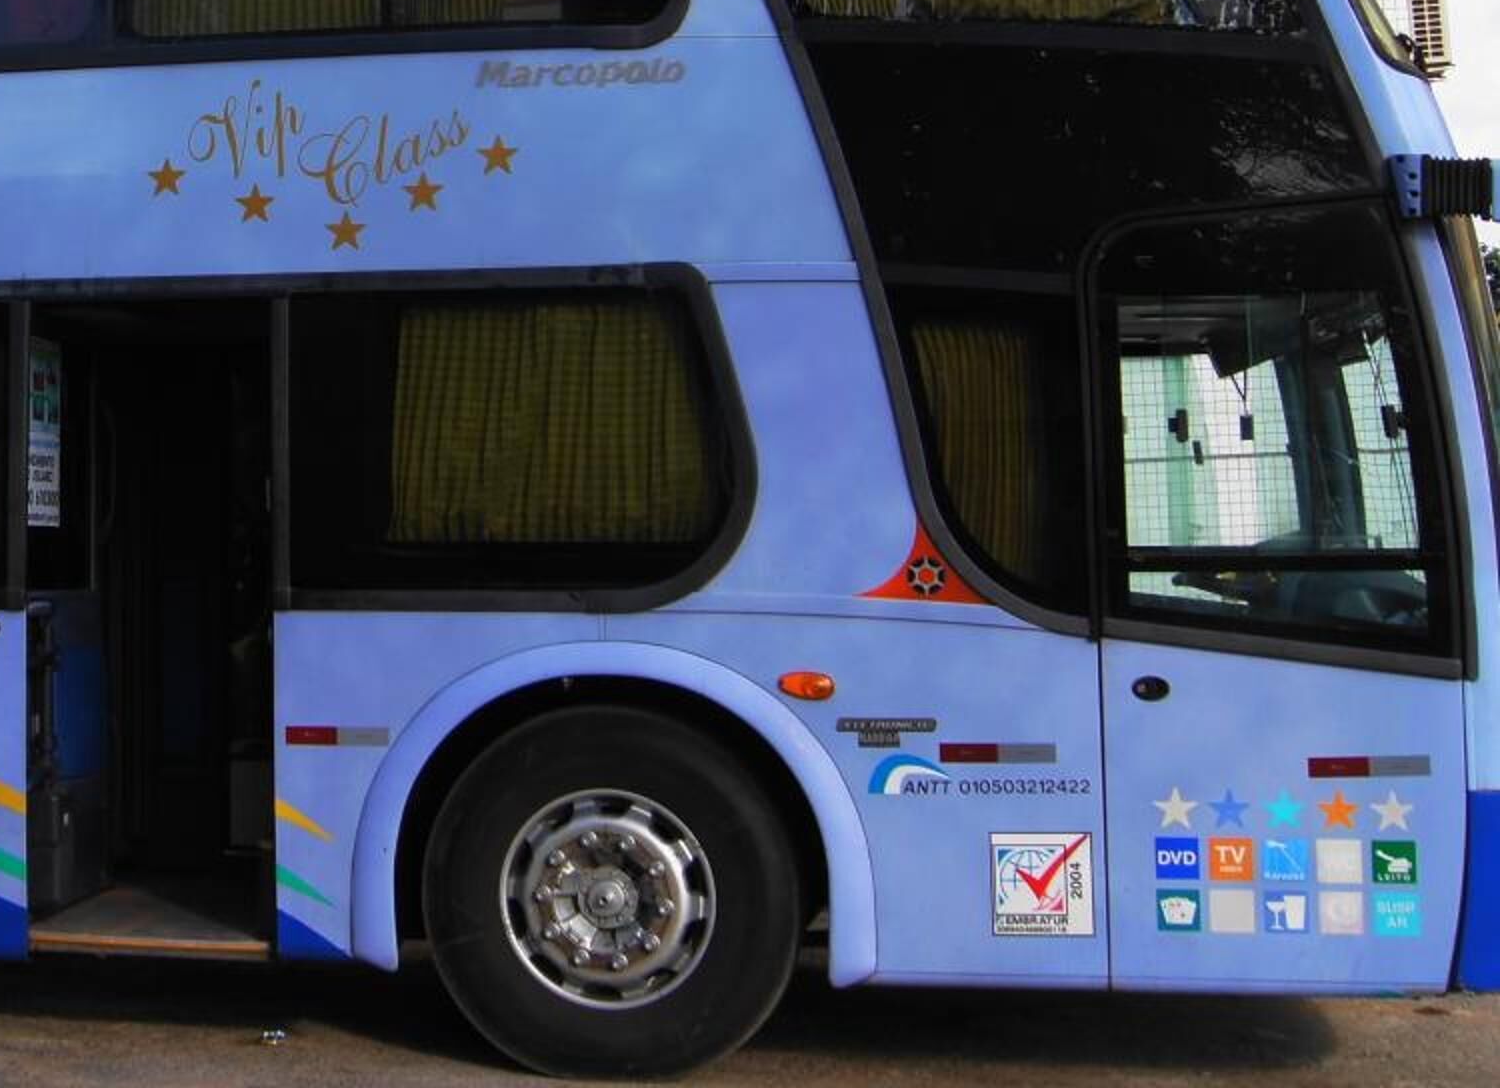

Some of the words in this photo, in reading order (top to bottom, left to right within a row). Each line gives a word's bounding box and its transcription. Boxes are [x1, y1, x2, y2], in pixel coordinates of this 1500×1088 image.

[475, 58, 686, 88] Marcopolo
[187, 78, 306, 180] Vip
[298, 109, 471, 209] Class
[903, 780, 951, 795] ANTT
[959, 778, 1091, 795] 010503212422
[1157, 850, 1197, 866] DVD
[1215, 845, 1246, 864] TV
[1068, 861, 1084, 900] 2004
